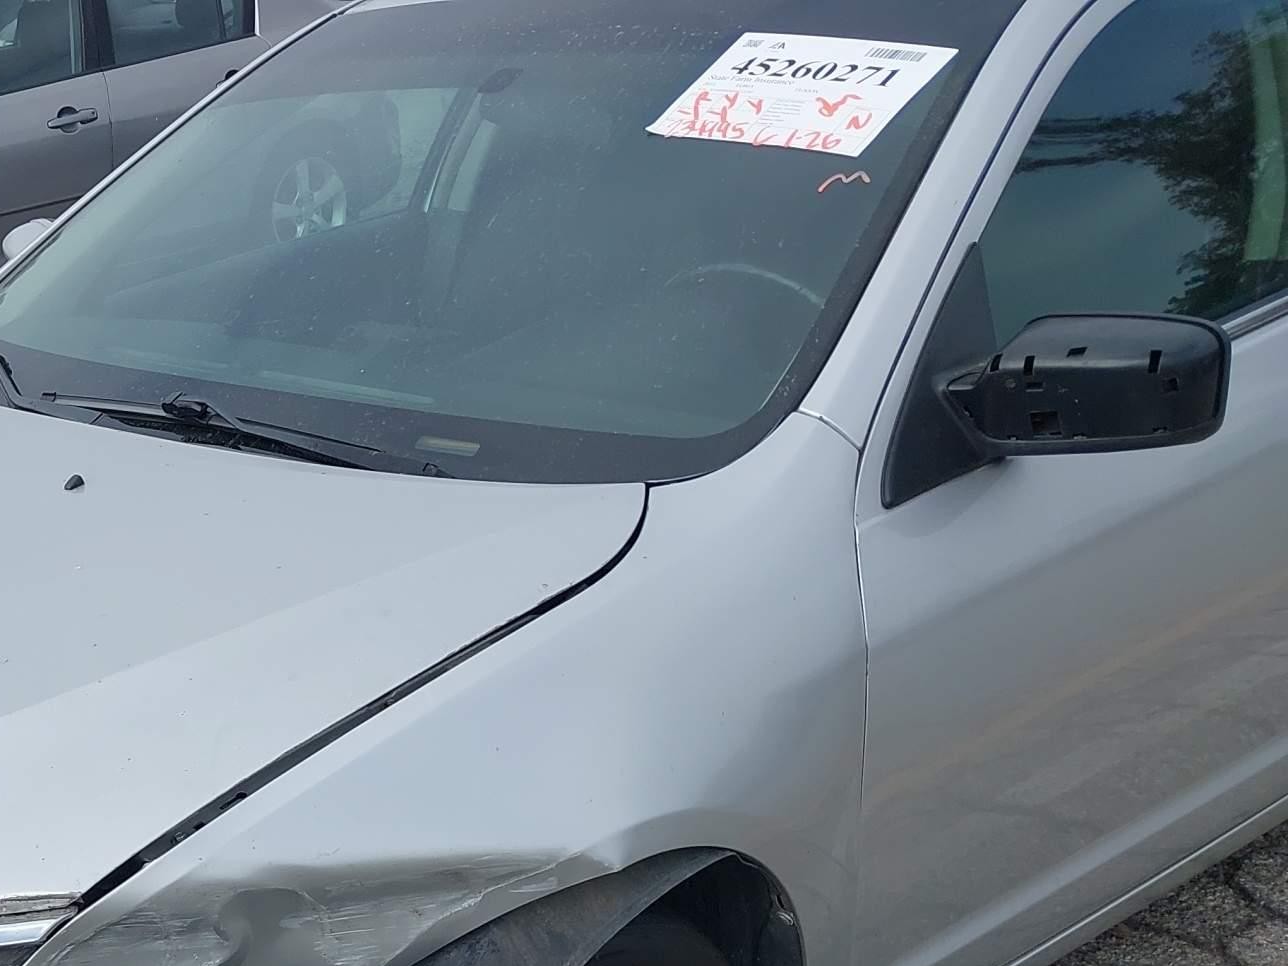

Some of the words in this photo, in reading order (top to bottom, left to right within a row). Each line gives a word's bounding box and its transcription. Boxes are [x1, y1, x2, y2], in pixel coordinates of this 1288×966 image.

[730, 75, 752, 83] Farm
[754, 76, 796, 86] Insurance
[731, 56, 902, 88] 45260271
